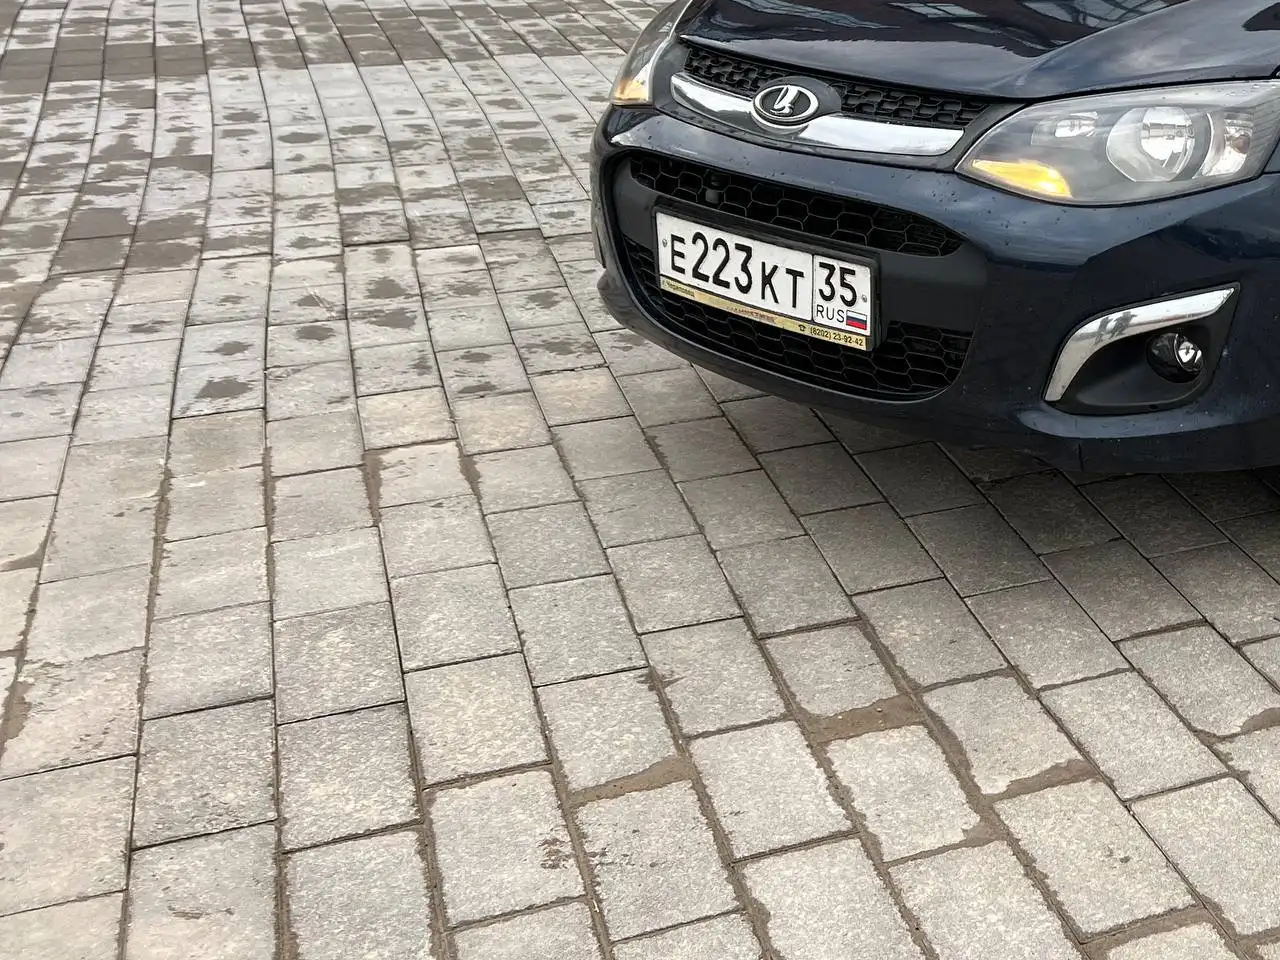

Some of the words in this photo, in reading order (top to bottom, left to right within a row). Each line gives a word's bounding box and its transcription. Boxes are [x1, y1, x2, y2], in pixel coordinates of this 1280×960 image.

[818, 262, 857, 307] 35
[816, 304, 845, 323] RUS
[810, 327, 832, 340] (8202)
[833, 332, 864, 346] 23-92-42
